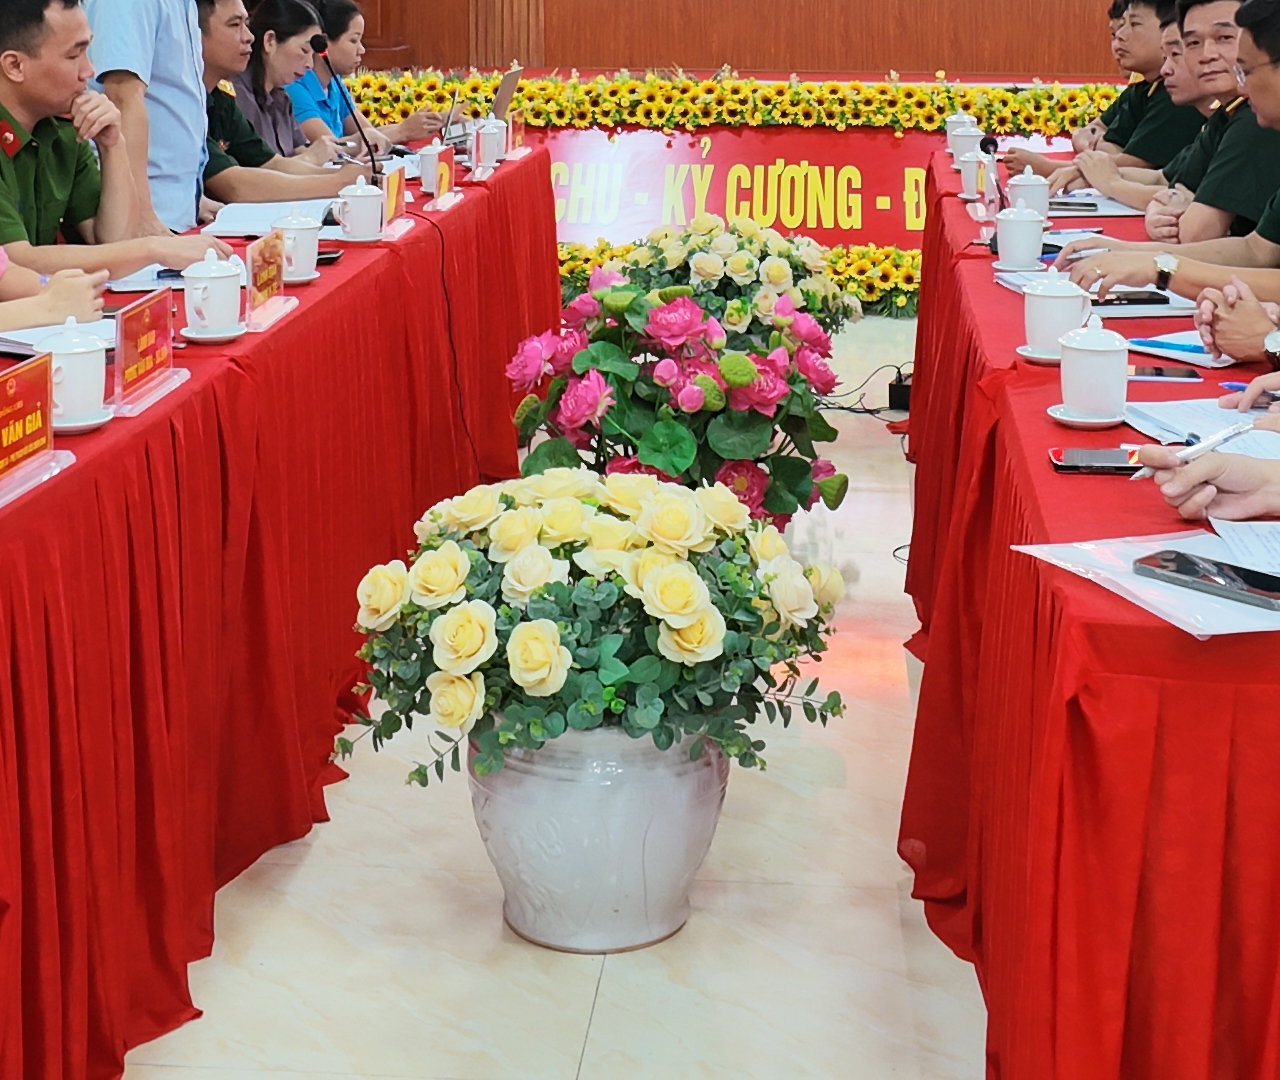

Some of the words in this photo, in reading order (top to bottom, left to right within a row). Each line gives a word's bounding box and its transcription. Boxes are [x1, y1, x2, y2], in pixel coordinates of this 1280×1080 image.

[551, 134, 622, 225] CHỦ
[662, 137, 715, 225] KỶ
[726, 158, 862, 229] CƯƠNG
